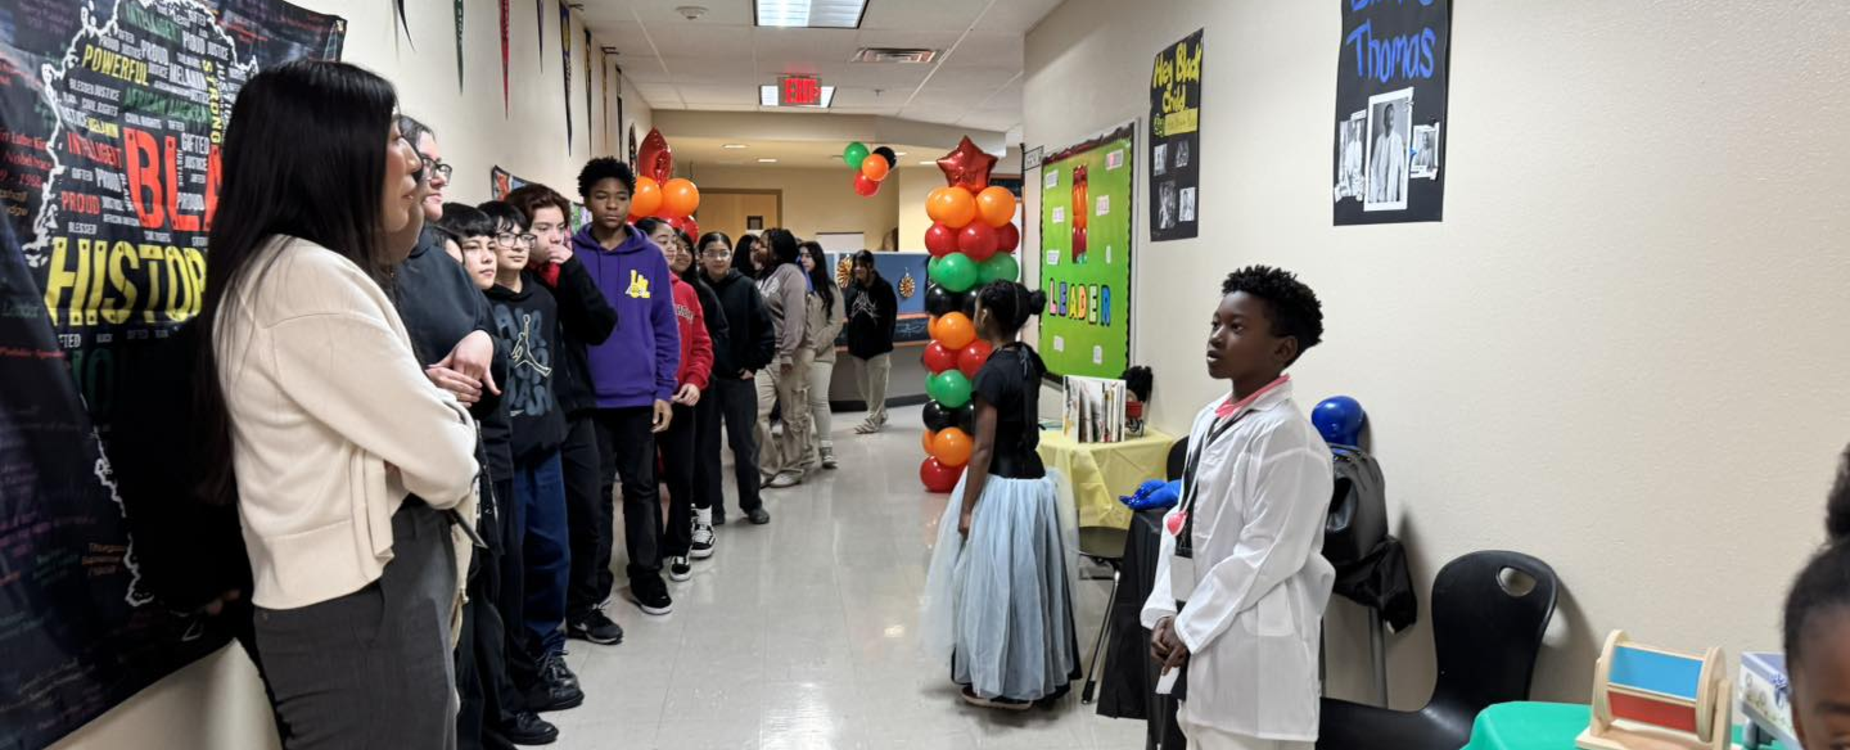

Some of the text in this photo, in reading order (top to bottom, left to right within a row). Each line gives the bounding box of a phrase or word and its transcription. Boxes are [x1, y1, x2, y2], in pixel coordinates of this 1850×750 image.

[82, 44, 150, 87] POWERFUL
[1153, 41, 1202, 91] Hey Black
[1346, 18, 1437, 83] Thomas
[202, 59, 222, 144] STRONG
[785, 78, 818, 104] EXIT
[1163, 84, 1187, 114] Child
[181, 132, 210, 155] GIFTED
[61, 190, 100, 216] PROUD
[1049, 277, 1111, 327] LEADER
